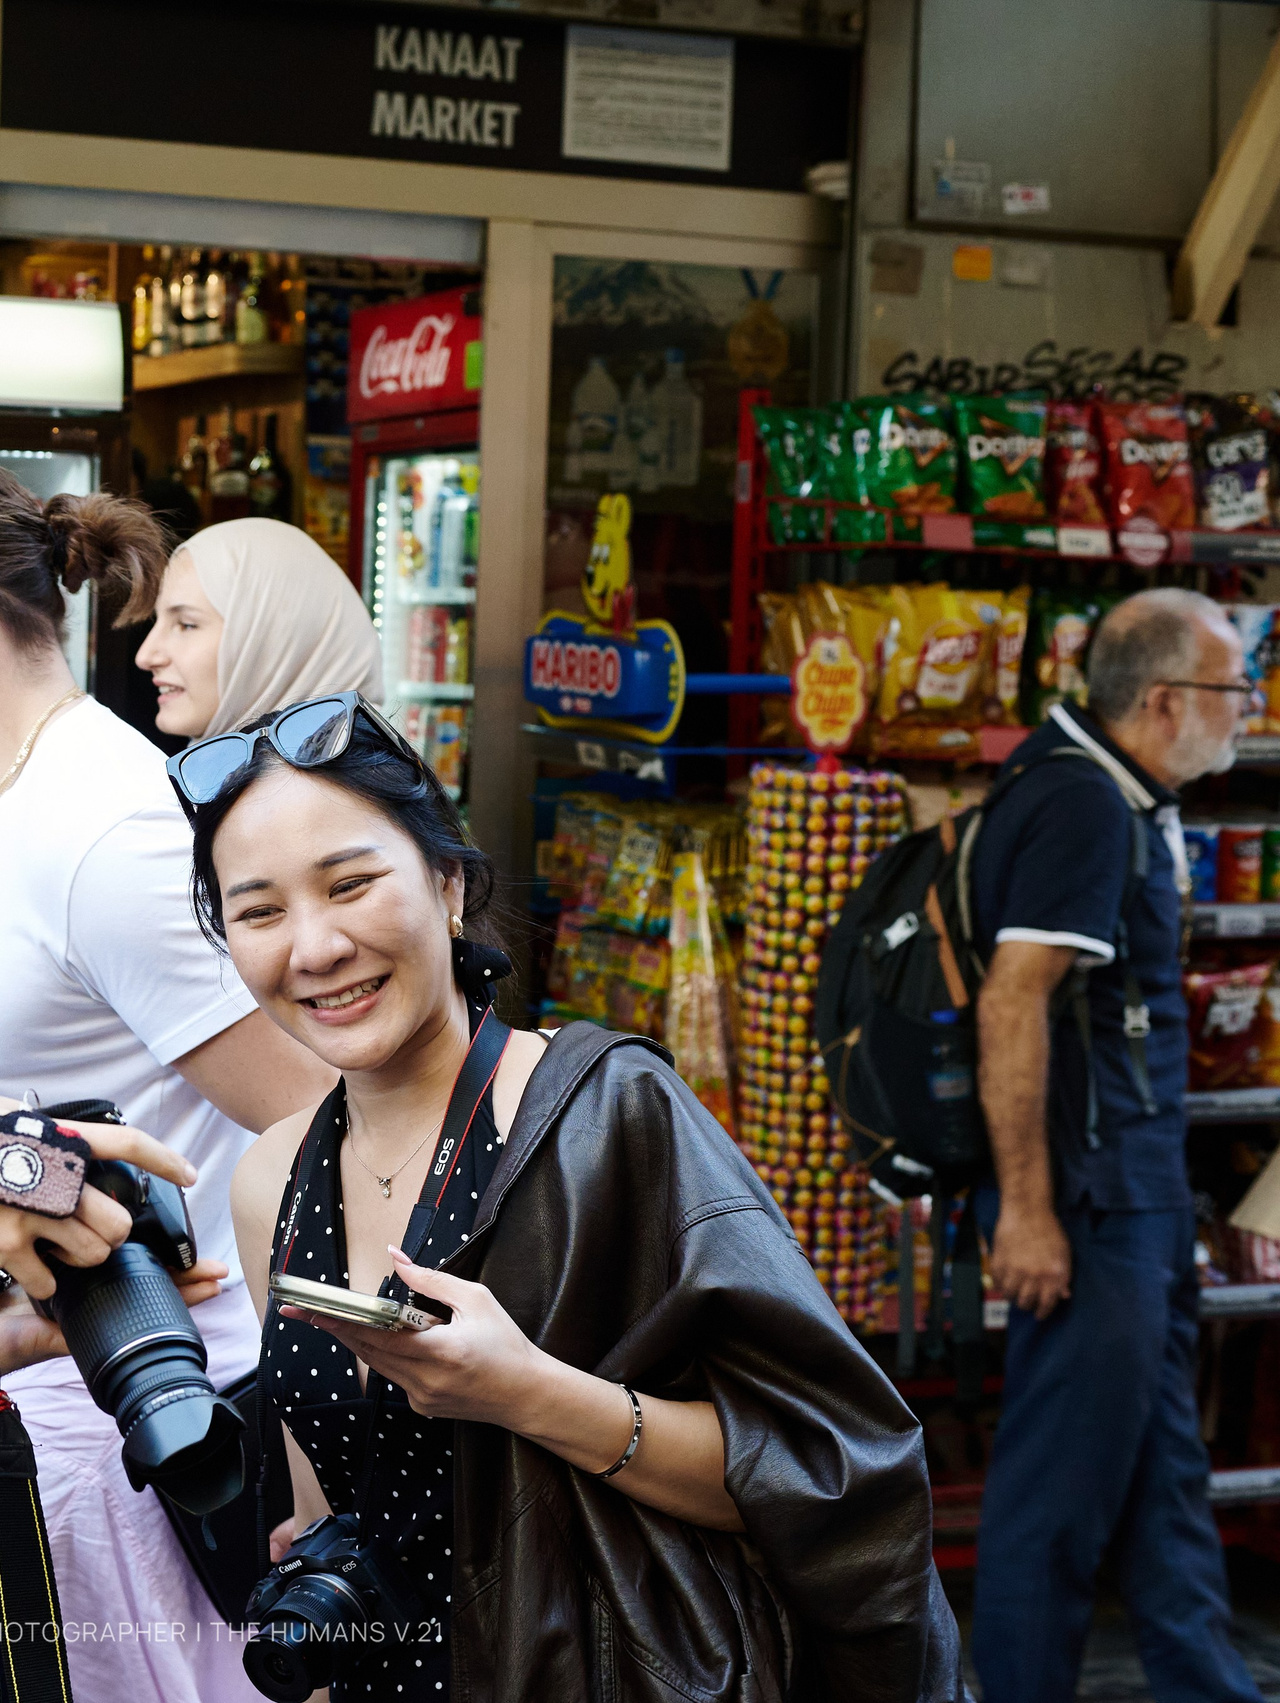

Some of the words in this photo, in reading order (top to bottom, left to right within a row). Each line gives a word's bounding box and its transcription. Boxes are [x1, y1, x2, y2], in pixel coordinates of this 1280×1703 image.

[375, 23, 521, 83] KANAAT
[372, 90, 521, 147] MARKET
[531, 639, 621, 698] HARIBO
[433, 1137, 455, 1176] EOS
[283, 1191, 302, 1245] Canon
[177, 1242, 193, 1269] Nikon
[278, 1559, 303, 1574] Canon
[341, 1560, 357, 1573] EOS
